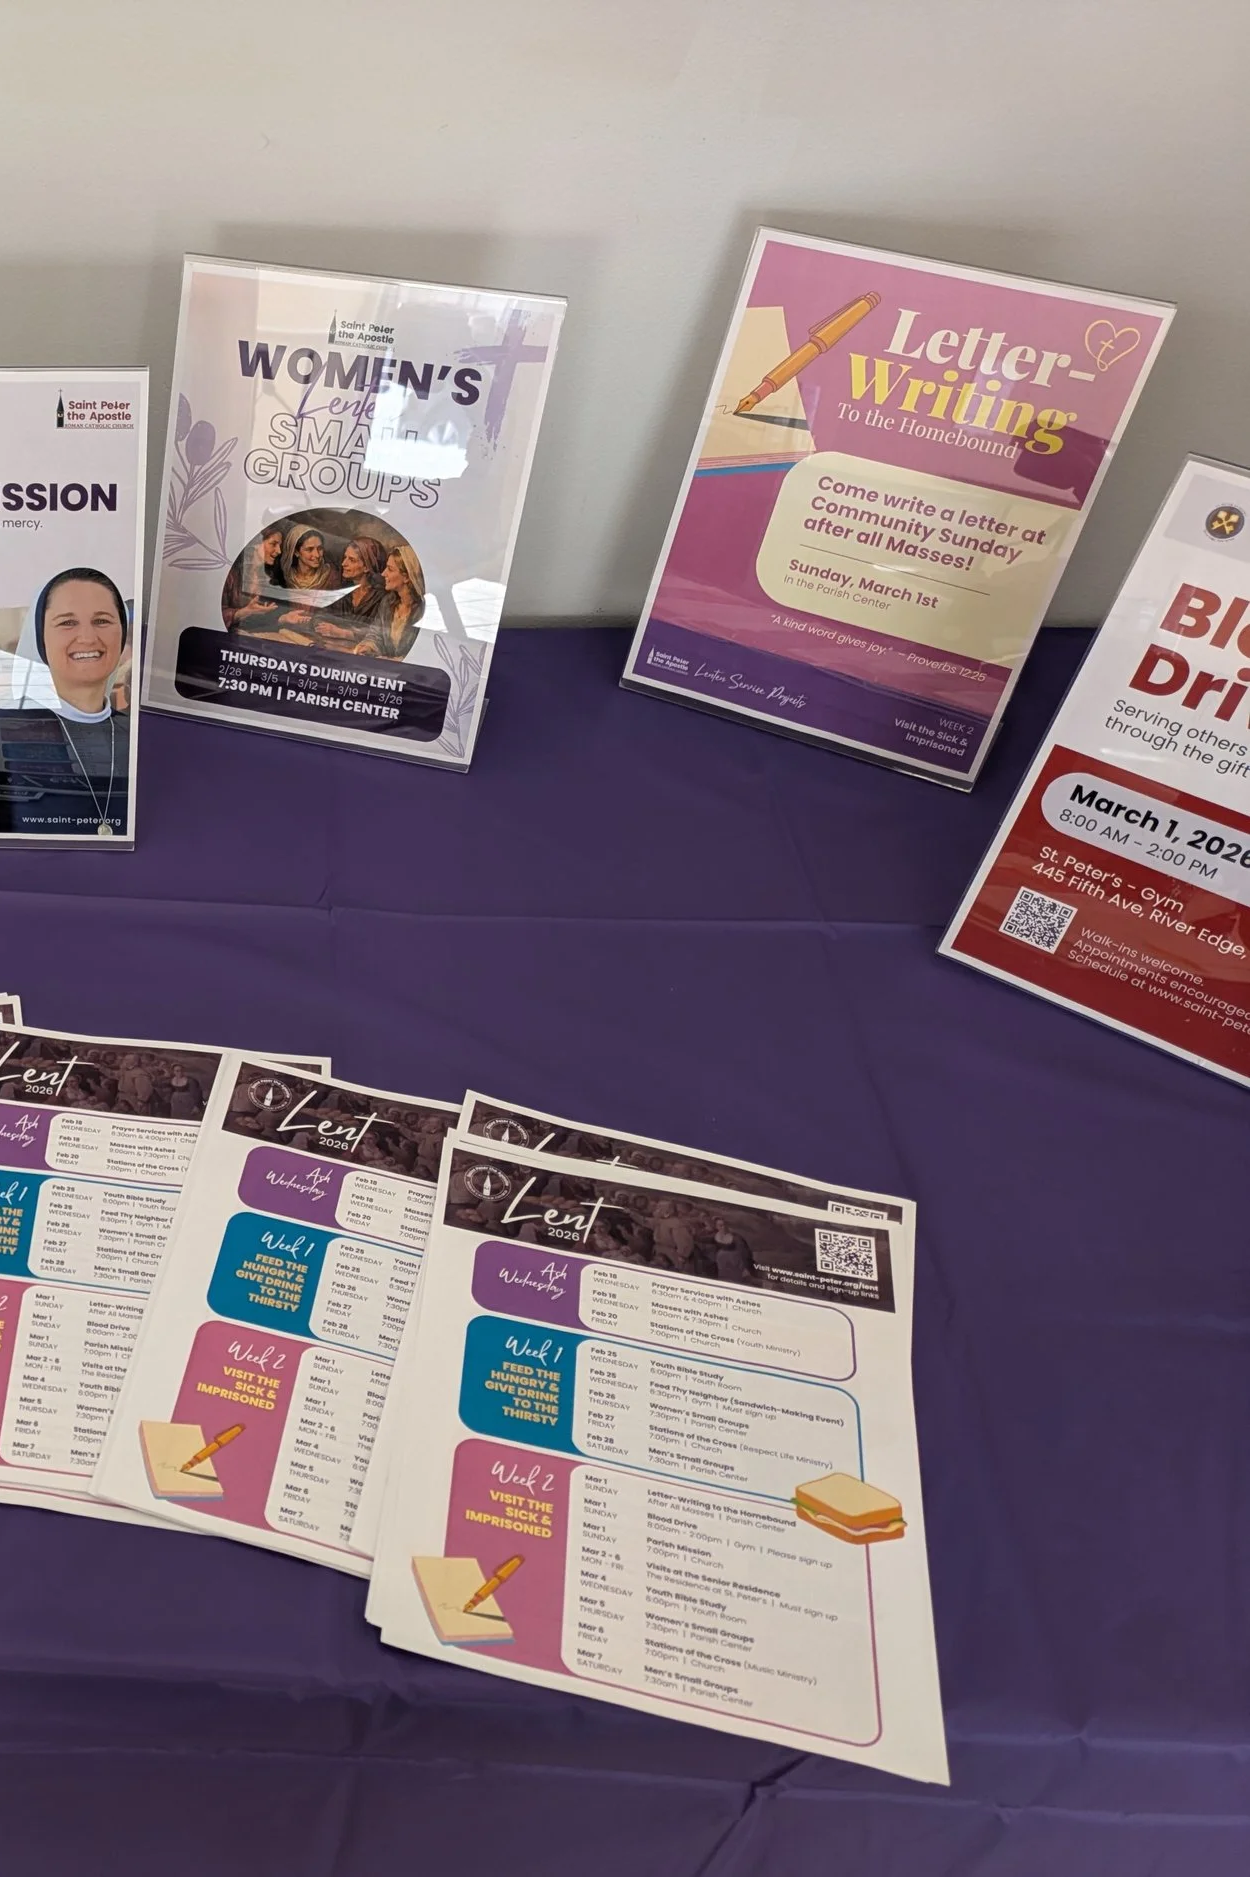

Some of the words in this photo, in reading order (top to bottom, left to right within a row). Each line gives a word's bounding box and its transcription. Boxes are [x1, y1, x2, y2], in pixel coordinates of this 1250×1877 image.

[884, 308, 1096, 387] Letter-
[238, 339, 482, 405] WOMEN'S
[849, 352, 1077, 455] Writing
[837, 402, 860, 422] To
[864, 409, 894, 430] the
[898, 416, 1019, 459] Homebound
[2, 520, 43, 530] mercy.
[811, 496, 934, 542] Community
[938, 528, 1023, 566] Sunday
[818, 476, 878, 502] Come
[883, 495, 936, 516] write
[958, 510, 1018, 537] letter
[1021, 528, 1046, 545] at
[804, 516, 853, 540] after
[857, 530, 883, 548] all
[886, 537, 974, 571] Masses!
[789, 559, 854, 588] Sunday,
[858, 577, 912, 602] March
[915, 592, 938, 609] 1st
[816, 582, 850, 600] Parish
[852, 592, 891, 610] Center
[220, 649, 307, 675] THURSDAYS
[310, 665, 368, 685] DURING
[370, 677, 406, 692] LENT
[907, 653, 957, 674] Proverbs
[959, 667, 986, 682] 12:25
[218, 677, 248, 692] 7:30
[250, 683, 272, 697] PM
[286, 689, 340, 709] PARISH
[343, 700, 400, 720] CENTER
[1105, 715, 1178, 751] through
[1182, 742, 1213, 764] the
[1114, 699, 1183, 736] Serving
[1187, 727, 1247, 757] others
[1070, 784, 1159, 832] March
[1164, 819, 1179, 843] 1,
[1059, 809, 1097, 832] 8:00
[1100, 826, 1130, 845] AM
[1146, 843, 1186, 866] 2:00
[1189, 860, 1218, 880] PM
[1039, 846, 1058, 864] St.
[1063, 855, 1123, 888] Peter's
[1032, 862, 1065, 882] 445
[1068, 872, 1104, 900] Fifth
[1108, 893, 1144, 918] Ave,
[1149, 908, 1195, 935] River
[1197, 928, 1246, 960] Edge,
[1081, 927, 1138, 958] Walk-ins
[1140, 952, 1204, 986] welcome.
[276, 1090, 394, 1152] Lent
[501, 1176, 623, 1243] Lent
[548, 1227, 580, 1241] 2026
[541, 1262, 568, 1280] Ash
[772, 1267, 878, 1291] www.saint-peter.org/lent
[503, 1362, 534, 1375] FEED
[536, 1368, 560, 1381] THE
[506, 1336, 552, 1366] Week
[197, 1382, 275, 1410] IMPRISONED
[485, 1381, 516, 1393] GIVE
[518, 1386, 558, 1403] DRINK
[491, 1370, 548, 1389] HUNGRY
[502, 1406, 558, 1426] THIRSTY
[491, 1460, 540, 1495] Week
[490, 1490, 525, 1505] VISIT
[527, 1499, 553, 1513] THE
[505, 1507, 539, 1523] SICK
[647, 1489, 711, 1510] Letter-Writing
[740, 1510, 796, 1527] Homebound
[465, 1510, 552, 1538] IMPRISONED
[647, 1537, 675, 1549] Parish
[677, 1544, 711, 1557] Mission
